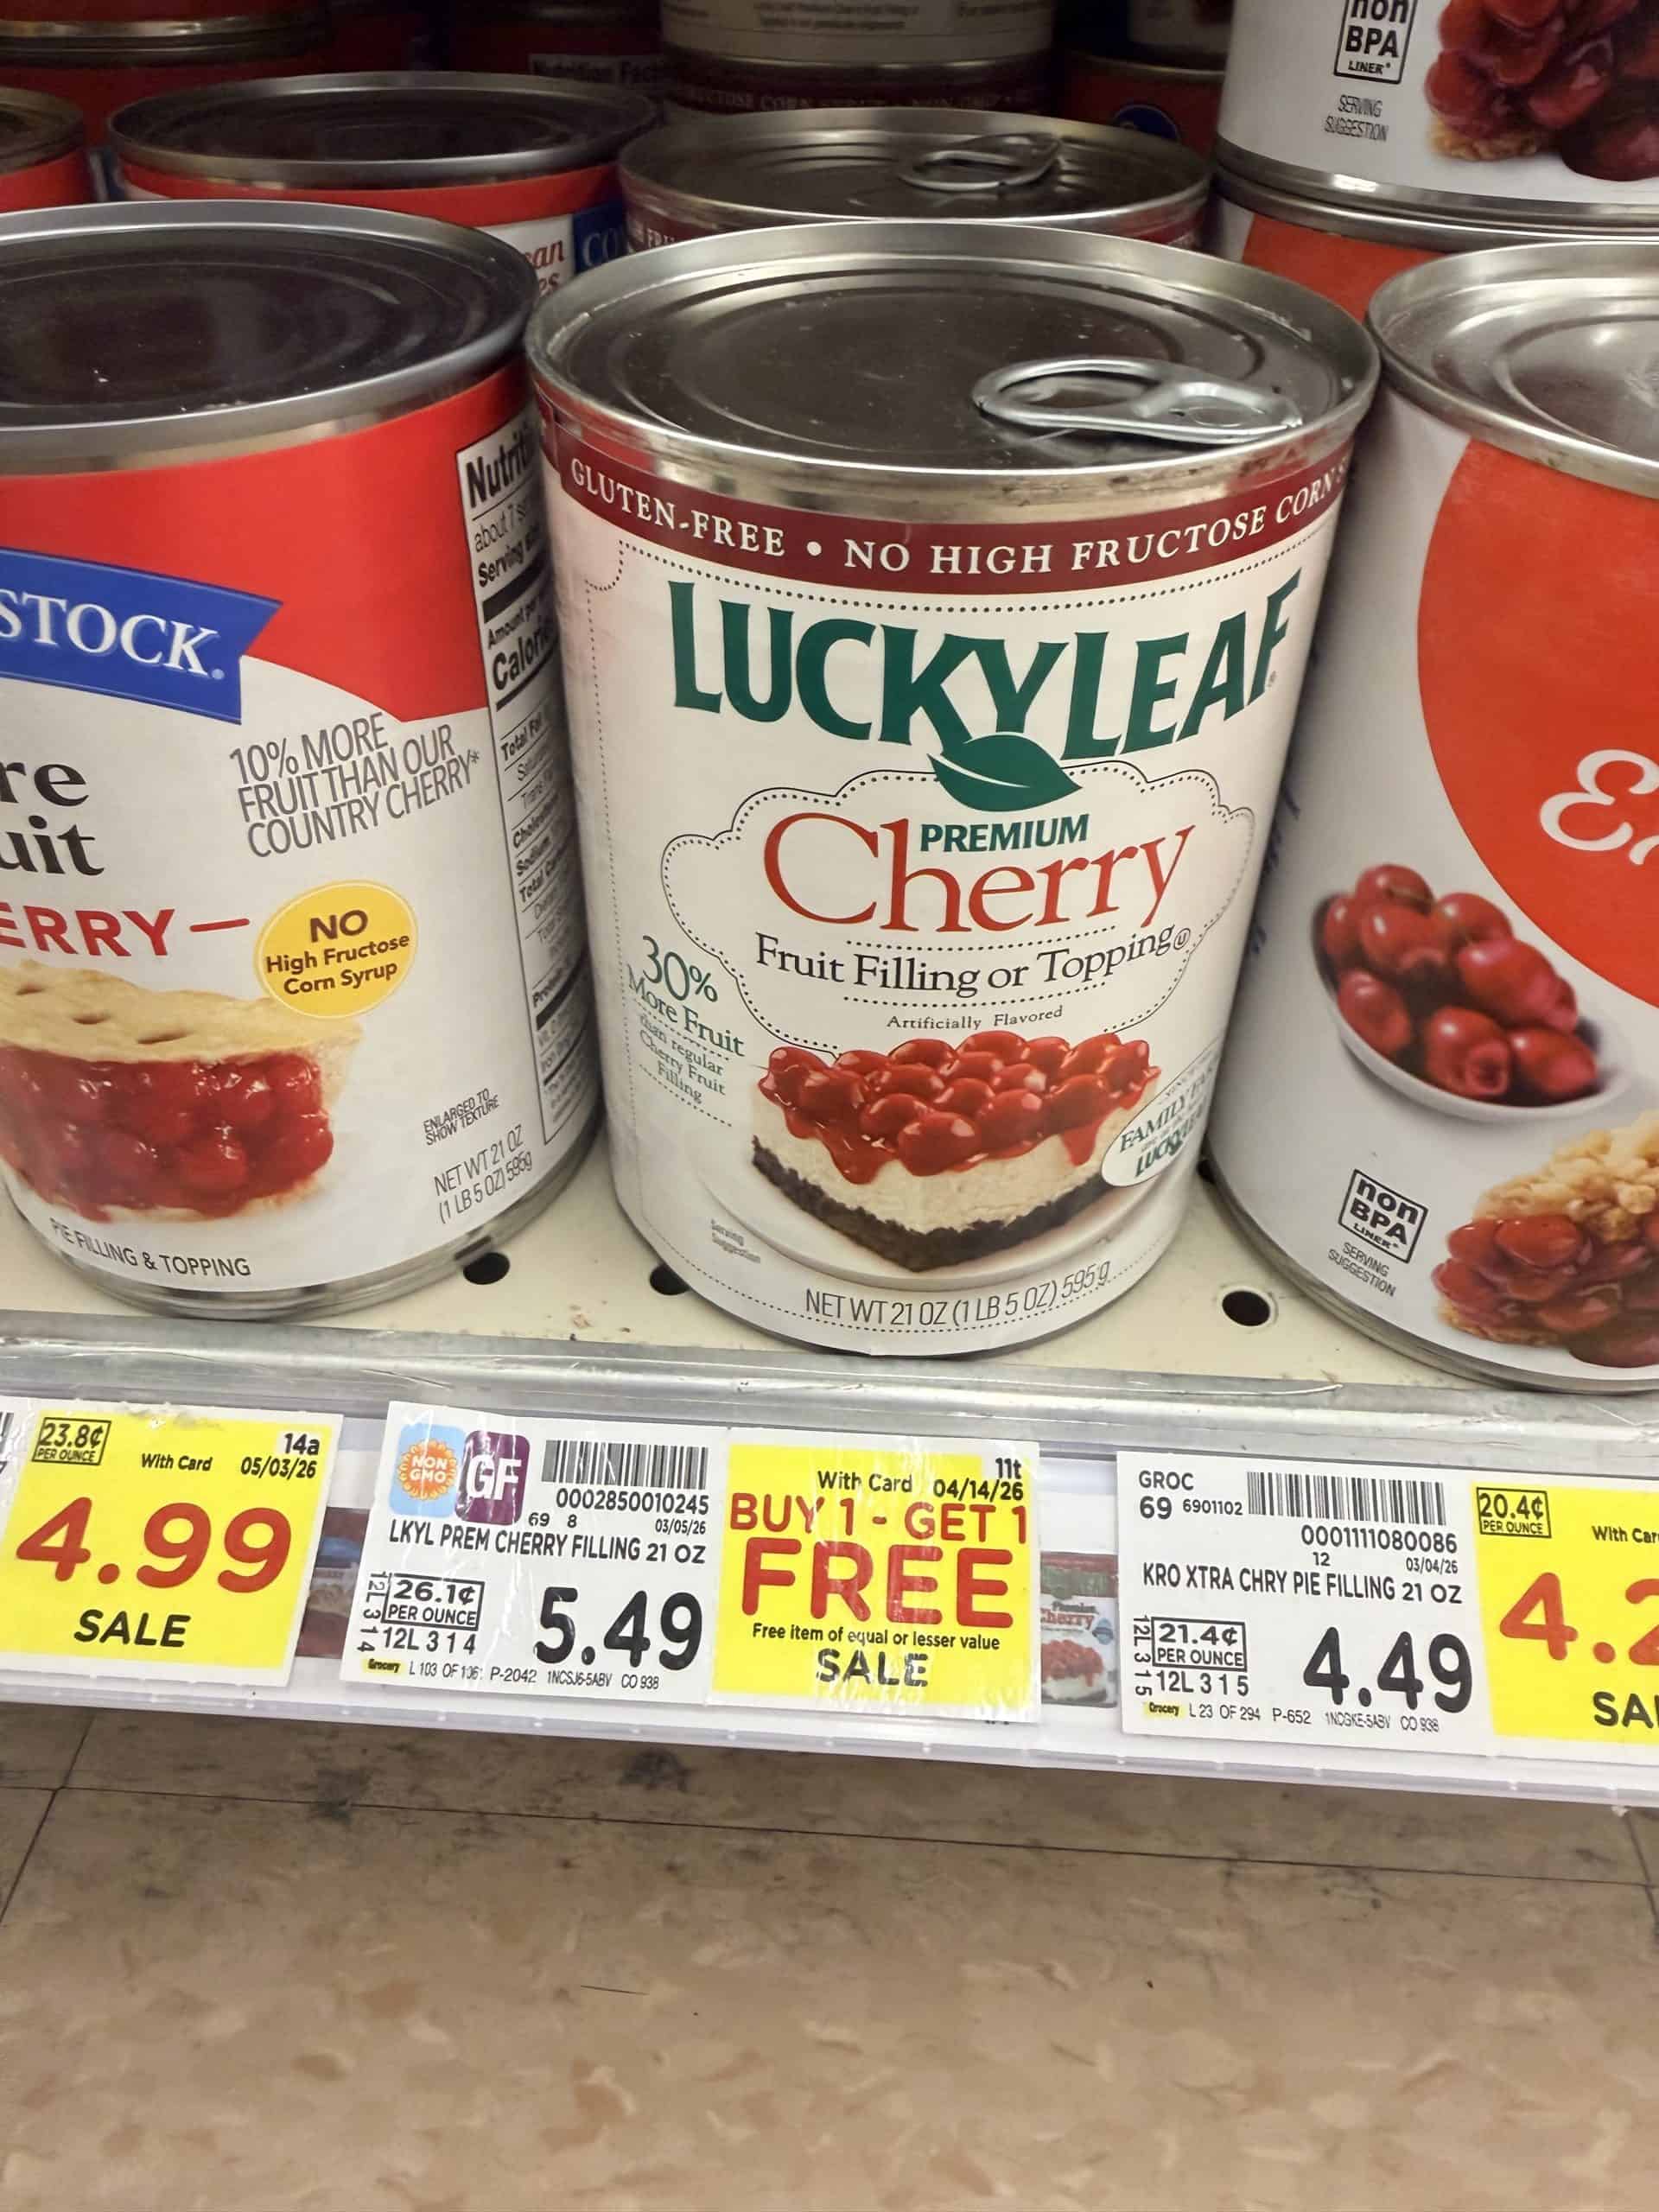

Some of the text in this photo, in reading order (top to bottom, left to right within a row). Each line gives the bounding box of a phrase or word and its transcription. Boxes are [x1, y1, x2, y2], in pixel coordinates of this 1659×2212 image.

[1345, 25, 1398, 58] BPA
[1348, 60, 1384, 73] LINER
[1338, 94, 1382, 118] SERVING
[1323, 116, 1389, 141] SUGGESTION
[570, 458, 785, 556] GLUTEN-FREE
[843, 539, 910, 571] NO
[930, 545, 1053, 574] HIGH
[1071, 506, 1267, 571] FRUCTOSE
[479, 541, 524, 588] Serving
[229, 712, 388, 785] 10% MORE
[238, 724, 455, 823] FRUIT THAN OUR
[248, 791, 379, 857] COUNTRY
[920, 814, 1089, 853] PREMIUM
[764, 811, 1196, 933] Cherry
[309, 910, 368, 943] NO
[266, 935, 410, 976] High Fructose
[642, 935, 718, 1002] 30%
[755, 925, 1175, 998] Fruit Filling or Topping
[283, 963, 397, 995] Corn Syrup
[627, 963, 678, 1023] More
[682, 1005, 746, 1057] Fruit
[887, 1006, 1063, 1031] Artificially Flavored
[671, 1038, 724, 1075] regular
[657, 1060, 702, 1104] Filling
[689, 1063, 726, 1096] Fruit
[423, 1088, 490, 1134] ENLARGED TO
[425, 1094, 500, 1146] SHOW TEXTURE
[434, 1123, 524, 1197] NET WT 21 OZ
[454, 1188, 472, 1214] LB
[474, 1182, 484, 1204] 5
[505, 1151, 533, 1181] 595g
[1357, 1179, 1418, 1224] non
[1350, 1197, 1407, 1244] BPA
[142, 1252, 158, 1271] &
[159, 1254, 251, 1276] TOPPING
[1328, 1249, 1396, 1297] SUGGESTION
[1343, 1242, 1389, 1277] SERVING
[806, 1288, 843, 1316] NET
[851, 1300, 887, 1324] WT
[893, 1302, 912, 1325] 21
[919, 1300, 947, 1325] OZ
[976, 1296, 1000, 1321] LB
[1006, 1292, 1018, 1316] 5
[39, 1422, 321, 1455] 23.8¢ 14a
[36, 1448, 96, 1463] PER OUNCE
[142, 1453, 316, 1479] With Card 05/03/26
[412, 1456, 448, 1470] NON
[995, 1457, 1022, 1480] 11t
[409, 1469, 447, 1483] GMO
[467, 1455, 522, 1501] GF
[817, 1471, 1024, 1501] With Card 04/14/26
[1139, 1471, 1194, 1491] GROC
[556, 1488, 709, 1516] 0002850010245
[730, 1492, 1027, 1544] BUY 1 GET 1
[1140, 1496, 1243, 1519] 69 6901102
[1478, 1493, 1544, 1520] 20.4¢
[528, 1512, 706, 1535] 69 8 03/05/26
[1300, 1524, 1458, 1554] 0001111080086
[1483, 1520, 1543, 1535] PER OUNCE
[1592, 1525, 1659, 1544] With Car
[16, 1497, 292, 1593] 4.99
[389, 1519, 706, 1564] LKYL PREM CHERRY FILLING 21 OZ
[1313, 1552, 1458, 1574] 12 03/04/26
[393, 1580, 476, 1605] 26.1¢
[741, 1536, 1014, 1629] FREE
[1143, 1562, 1463, 1604] KRO XTRA CHRY PIE FILLING 21 OZ
[73, 1609, 191, 1648] SALE
[388, 1605, 477, 1626] PER OUNCE
[534, 1586, 702, 1671] 5.49
[384, 1627, 419, 1651] 12L
[753, 1623, 1001, 1650] Free item of equal or lesser value
[1159, 1623, 1238, 1646] 21.4¢
[368, 1658, 401, 1674] Grocery
[419, 1662, 437, 1676] 103
[442, 1663, 459, 1677] OF
[490, 1666, 537, 1684] P-2042
[621, 1674, 638, 1688] CO
[816, 1648, 929, 1688] SALE
[1157, 1648, 1243, 1667] PER OUNCE
[1303, 1626, 1472, 1713] 4.49
[1156, 1669, 1194, 1693] 12L
[1149, 1703, 1312, 1725] Grocery 23 OF 294 P-652
[1592, 1691, 1659, 1729] SA
